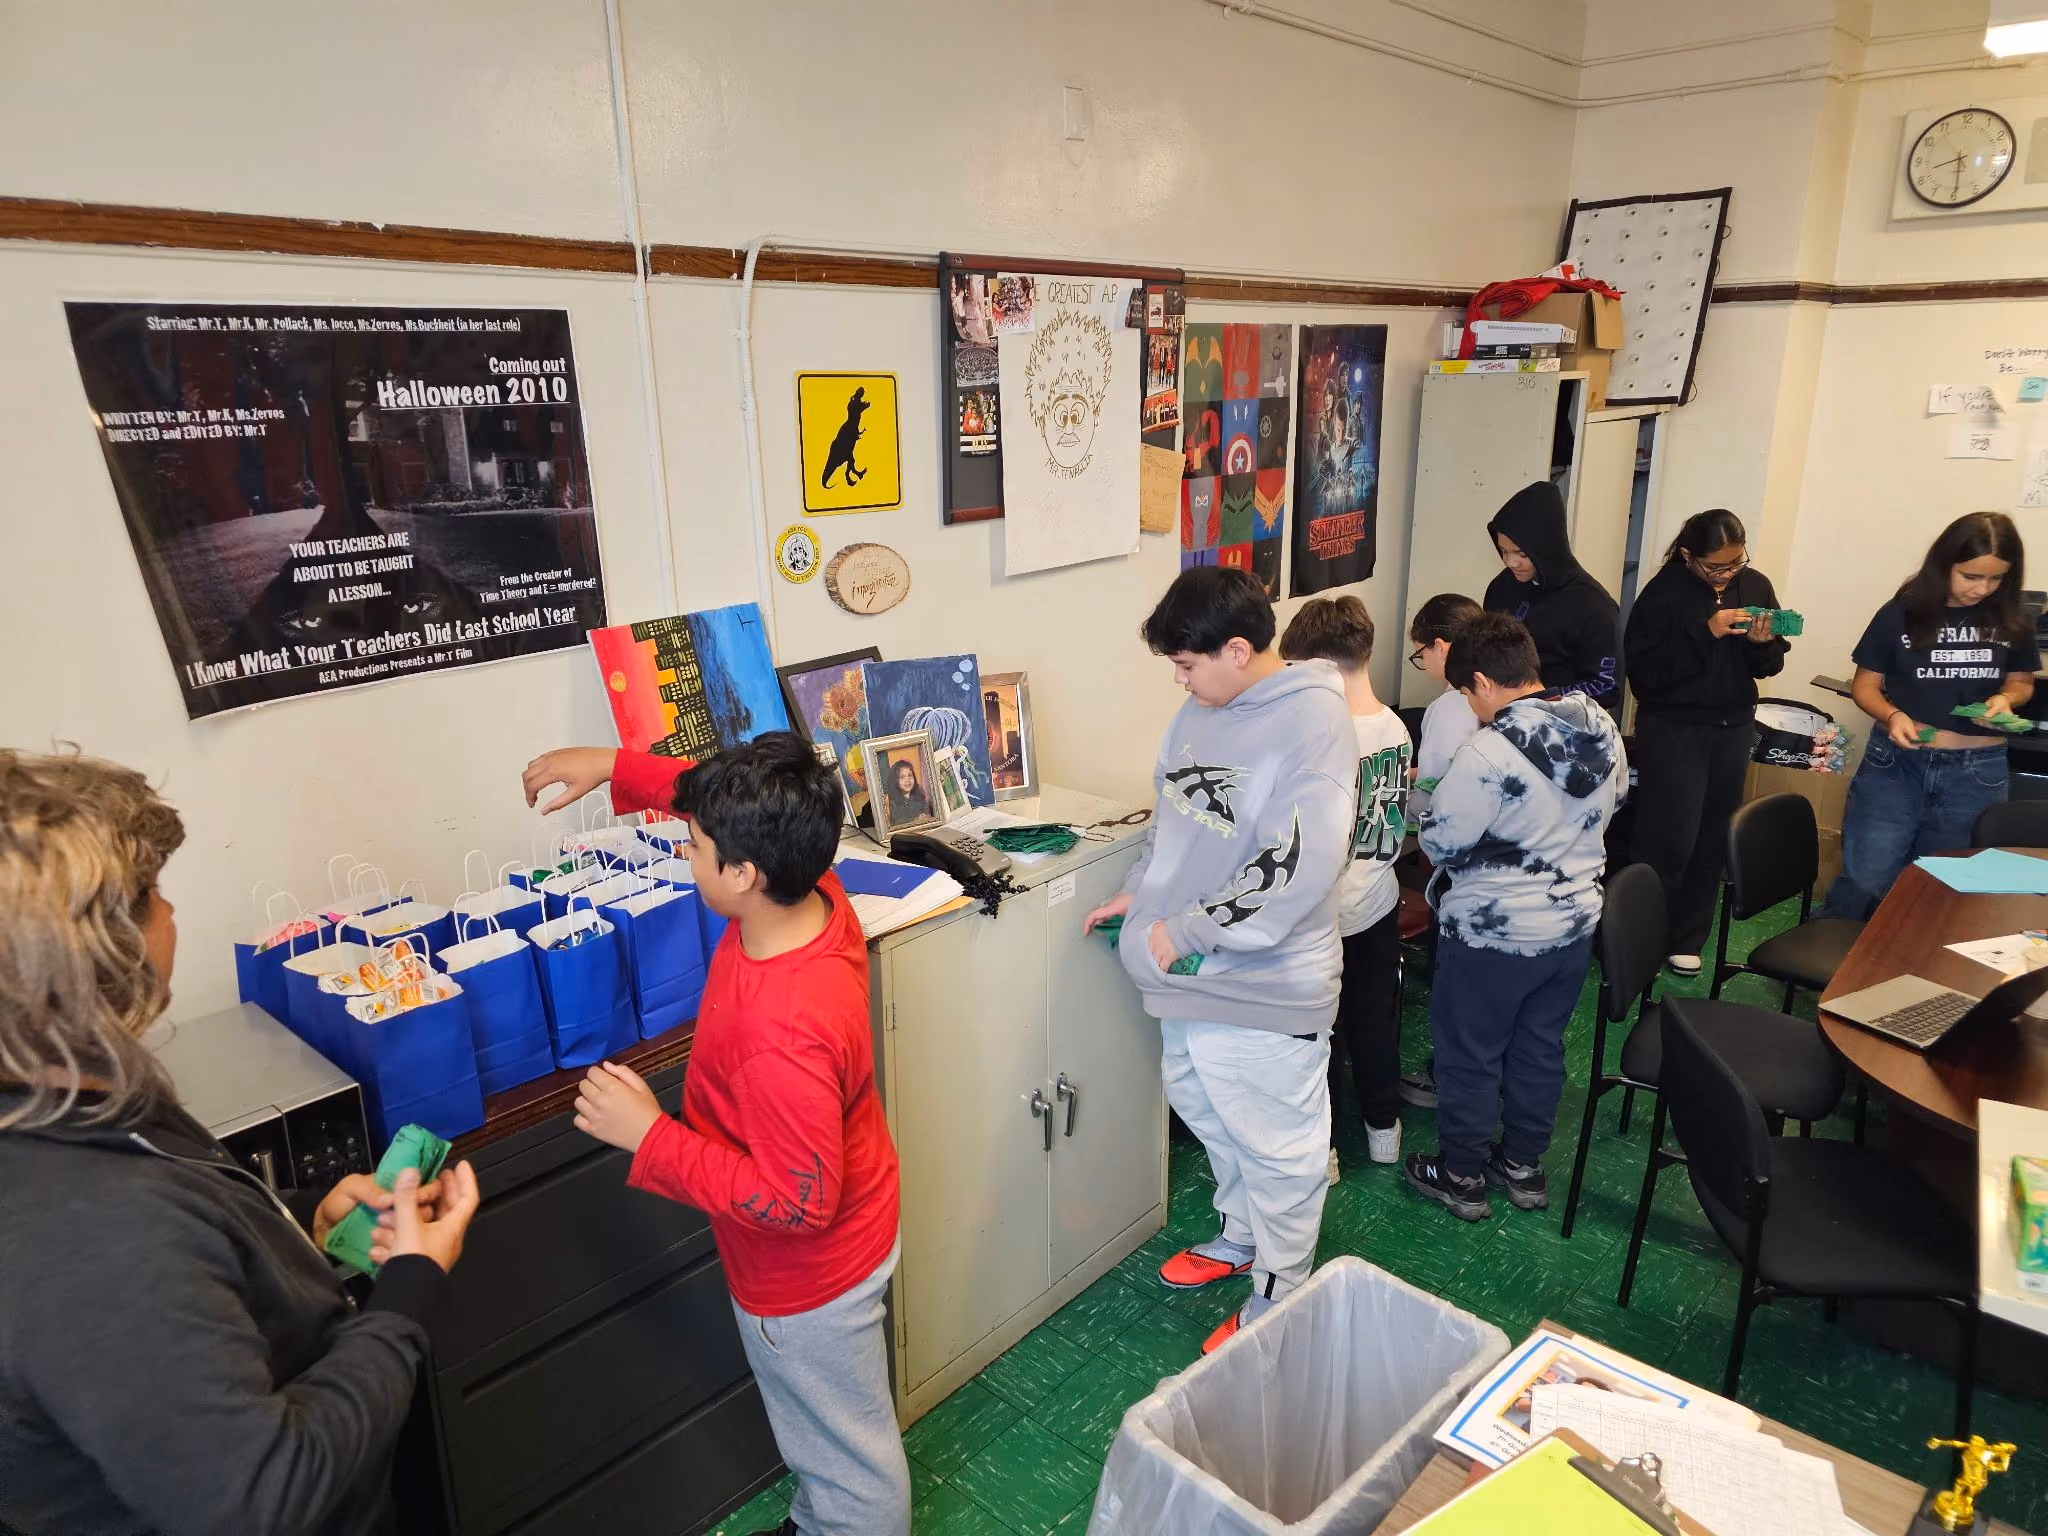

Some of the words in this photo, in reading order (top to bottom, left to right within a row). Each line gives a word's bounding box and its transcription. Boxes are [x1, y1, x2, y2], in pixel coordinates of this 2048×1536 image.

[1963, 113, 1974, 124] 12
[1997, 130, 2005, 140] 2
[1048, 282, 1096, 304] GREATEST
[147, 316, 197, 331] Starring:
[489, 356, 539, 374] Coming
[543, 358, 566, 373] out
[377, 380, 500, 408] Halloween
[506, 376, 567, 404] 2010
[102, 411, 154, 426] WRITTEN
[156, 411, 176, 423] BY:
[106, 427, 159, 442] DIRECTED
[162, 427, 181, 440] and
[184, 425, 222, 439] EDITED
[224, 424, 242, 437] BY:
[1309, 510, 1366, 550] STRANGER
[289, 541, 326, 559] YOUR
[326, 534, 387, 555] TEACHERS
[388, 532, 410, 548] ARE
[293, 563, 335, 583] ABOUT
[336, 562, 353, 578] TO
[354, 560, 370, 576] BE
[370, 554, 414, 573] TAUGHT
[500, 575, 519, 587] From
[521, 573, 533, 584] the
[534, 569, 562, 582] Creator
[564, 567, 572, 578] of
[328, 588, 338, 603] A
[338, 582, 392, 602] LESSON...
[500, 587, 528, 601] Theory
[529, 584, 542, 595] and
[186, 665, 196, 687] I
[194, 659, 237, 685] Know
[240, 647, 292, 675] What
[294, 642, 337, 666] Your
[341, 628, 422, 660] Teachers
[424, 622, 451, 645] Did
[455, 616, 490, 639] Last
[492, 608, 540, 635] School
[543, 605, 576, 626] Year
[1964, 650, 1989, 661] 1850
[338, 661, 388, 681] Productions
[390, 655, 426, 672] Presents
[427, 655, 433, 664] a
[455, 648, 473, 659] Film
[1916, 667, 2000, 679] CALIFORNIA
